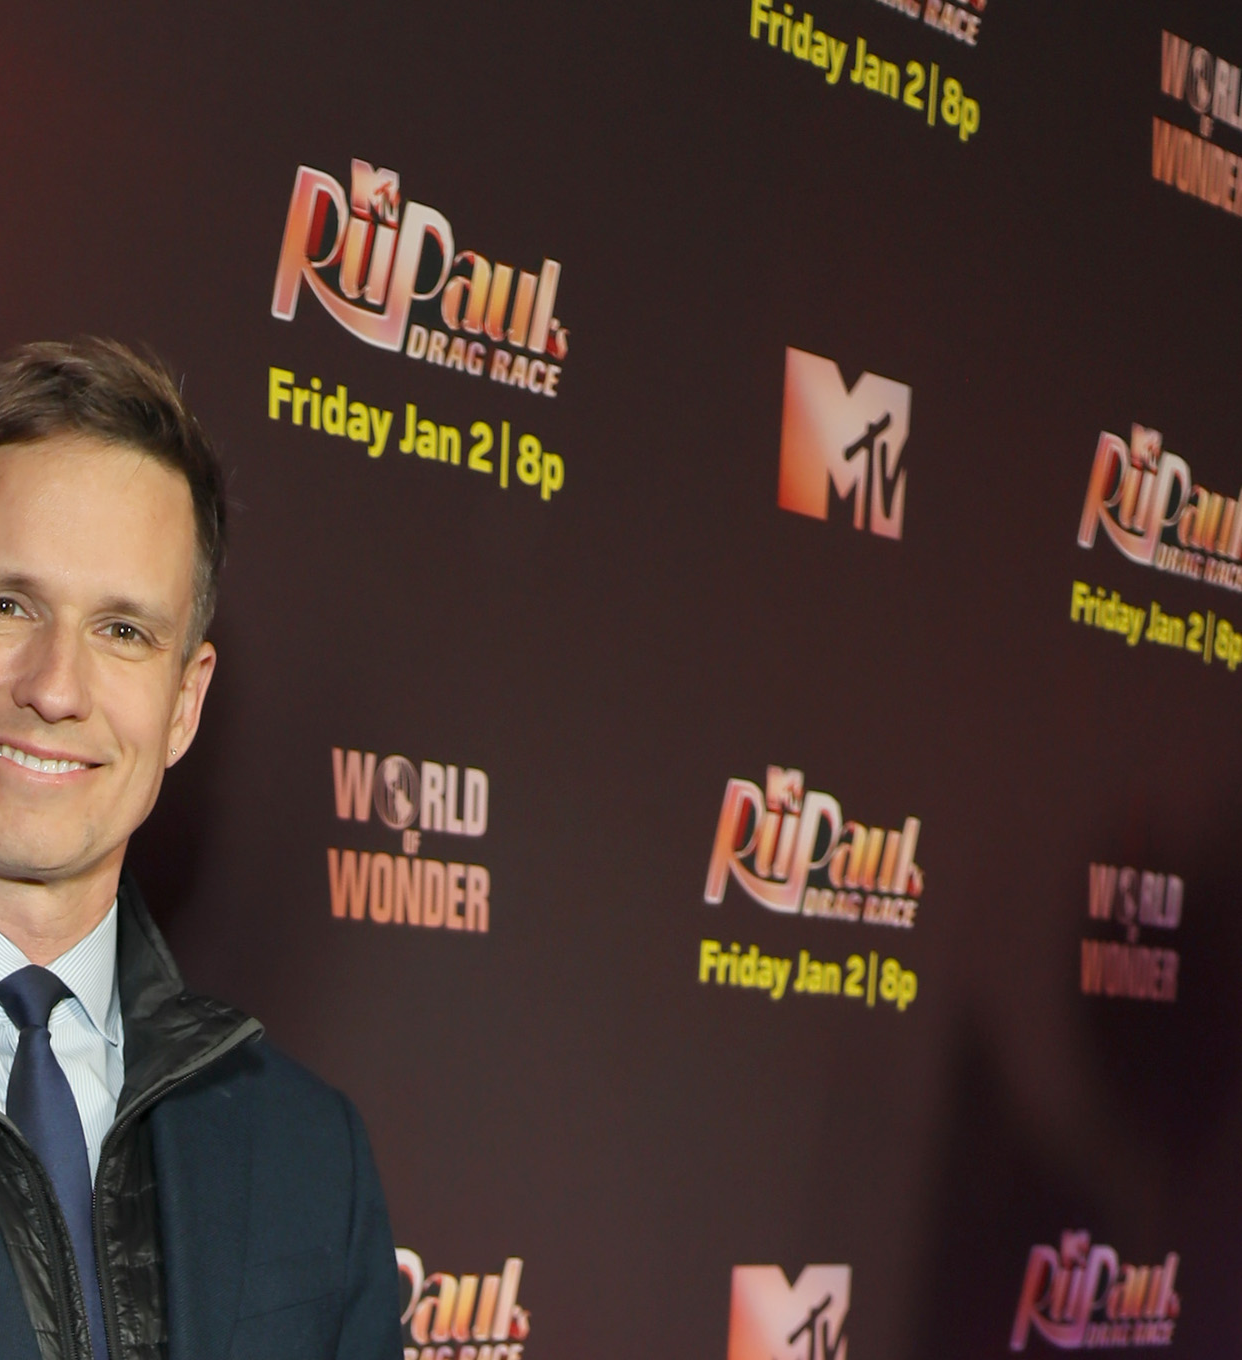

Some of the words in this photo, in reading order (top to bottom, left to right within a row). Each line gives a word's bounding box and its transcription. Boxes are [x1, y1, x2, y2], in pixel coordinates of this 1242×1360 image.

[750, 0, 849, 85] Friday
[849, 36, 901, 100] Jan
[903, 60, 926, 111] 2
[940, 76, 981, 143] 8p
[350, 157, 401, 224] MTV
[1152, 114, 1242, 219] WONDE
[270, 164, 570, 361] RuPaul's
[406, 324, 487, 377] DRAG
[490, 351, 562, 398] RACE
[268, 366, 394, 459] Friday
[399, 403, 462, 466] Jan
[468, 421, 494, 474] 2
[516, 434, 565, 502] 8p
[777, 345, 913, 541] MTV
[1070, 580, 1146, 646] Friday
[1145, 601, 1186, 648] Jan
[1185, 611, 1204, 653] 2
[331, 746, 490, 837] WORLD
[326, 847, 491, 934] WONDER
[698, 938, 792, 1002] Friday
[793, 949, 842, 995] Jan
[844, 954, 866, 997] 2
[879, 958, 918, 1013] 8p
